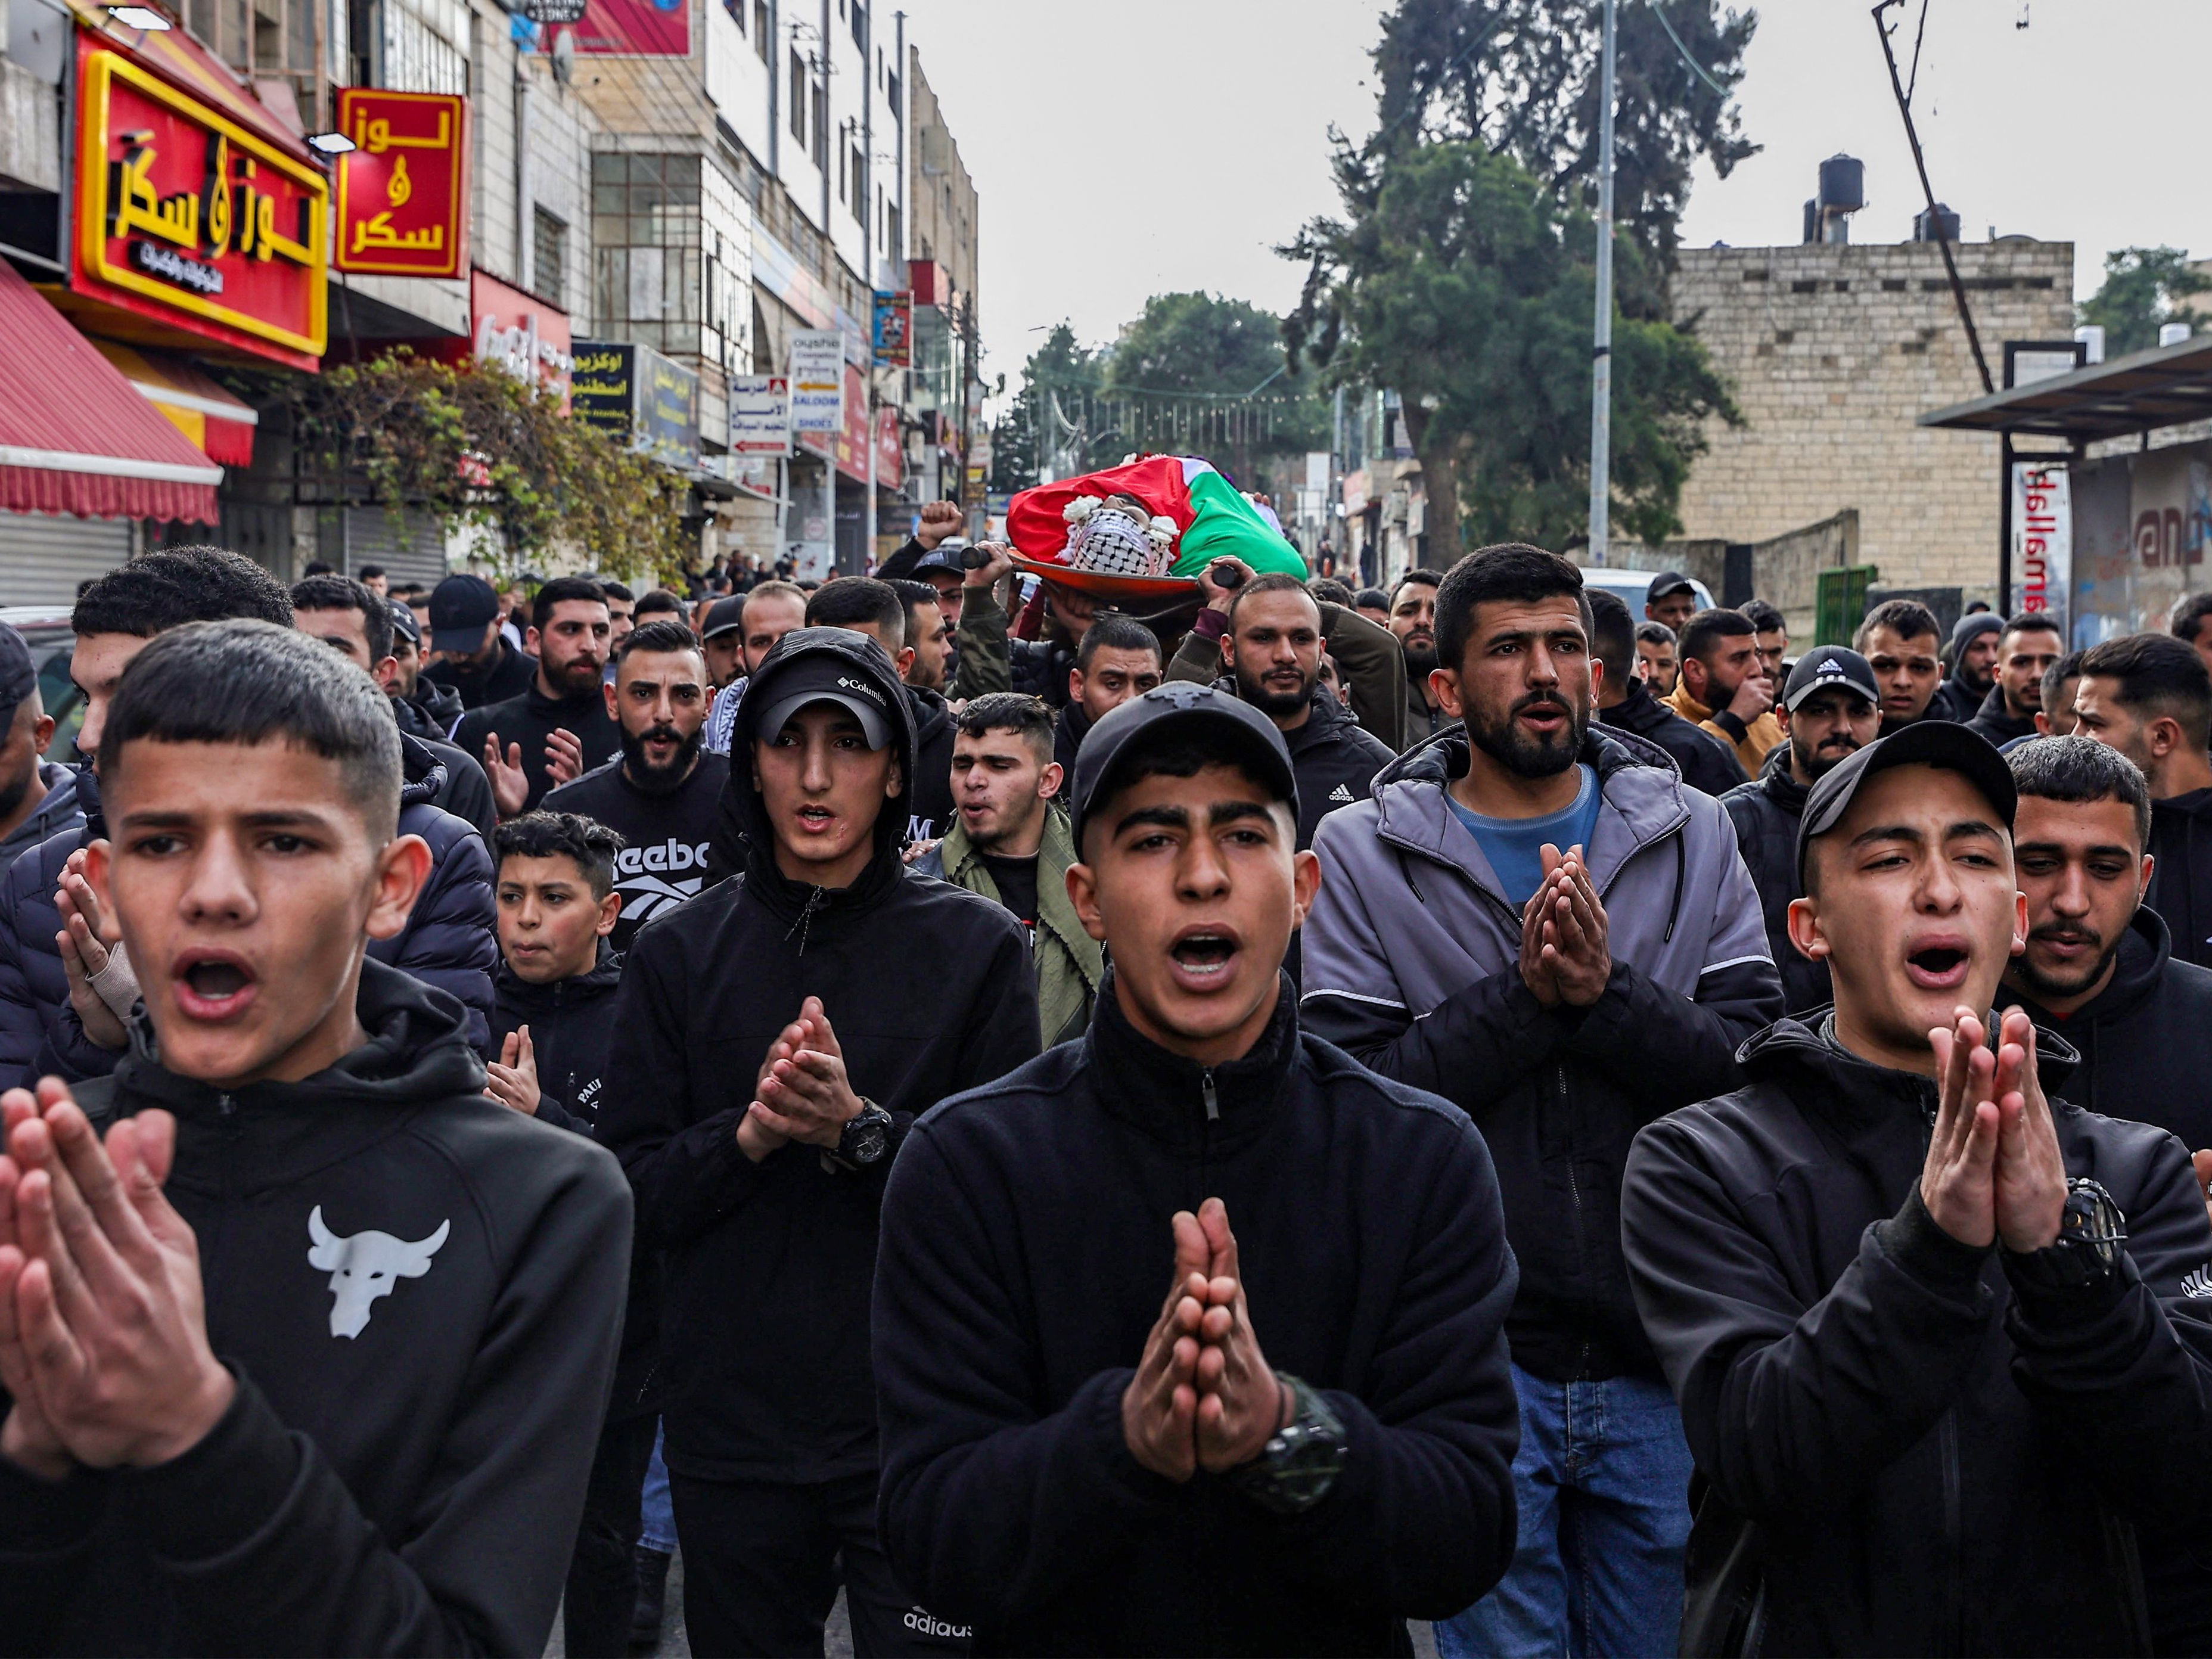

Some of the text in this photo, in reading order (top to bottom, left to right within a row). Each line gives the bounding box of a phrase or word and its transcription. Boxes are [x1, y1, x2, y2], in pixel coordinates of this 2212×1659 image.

[356, 107, 450, 153] لوز
[241, 159, 318, 268] لوز
[350, 211, 443, 253] سكر
[733, 377, 768, 396] مدرسة
[849, 679, 886, 707] Columbia
[613, 837, 710, 881] eebo
